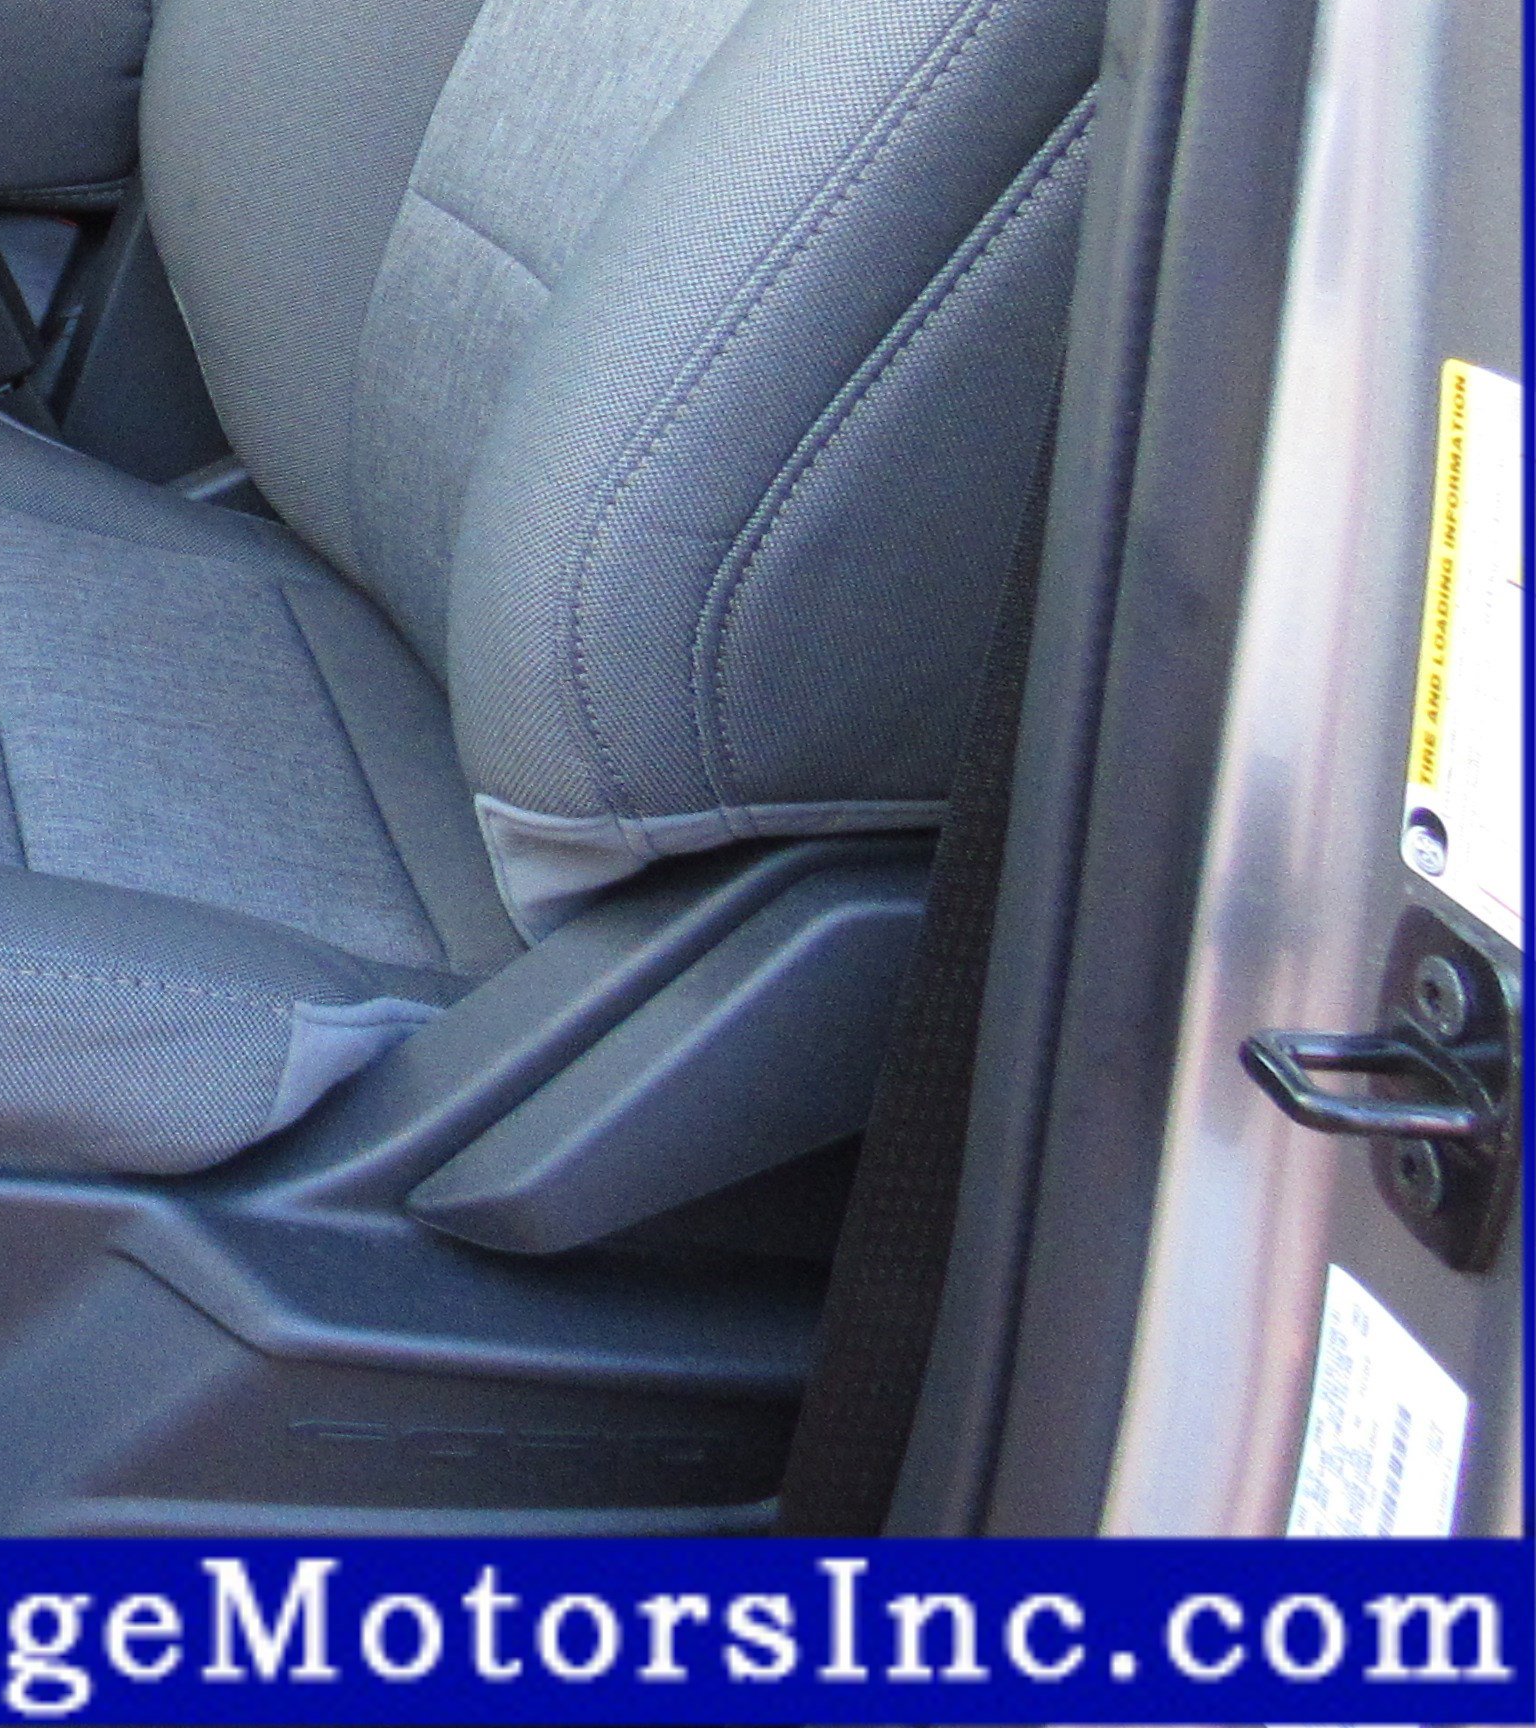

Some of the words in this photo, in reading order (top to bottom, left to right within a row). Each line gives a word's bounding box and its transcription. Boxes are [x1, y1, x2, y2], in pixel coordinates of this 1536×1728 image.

[1444, 374, 1467, 550] INFORMATION
[1433, 557, 1454, 666] LOADING
[1427, 672, 1442, 725] AND
[1419, 730, 1436, 785] TIRE
